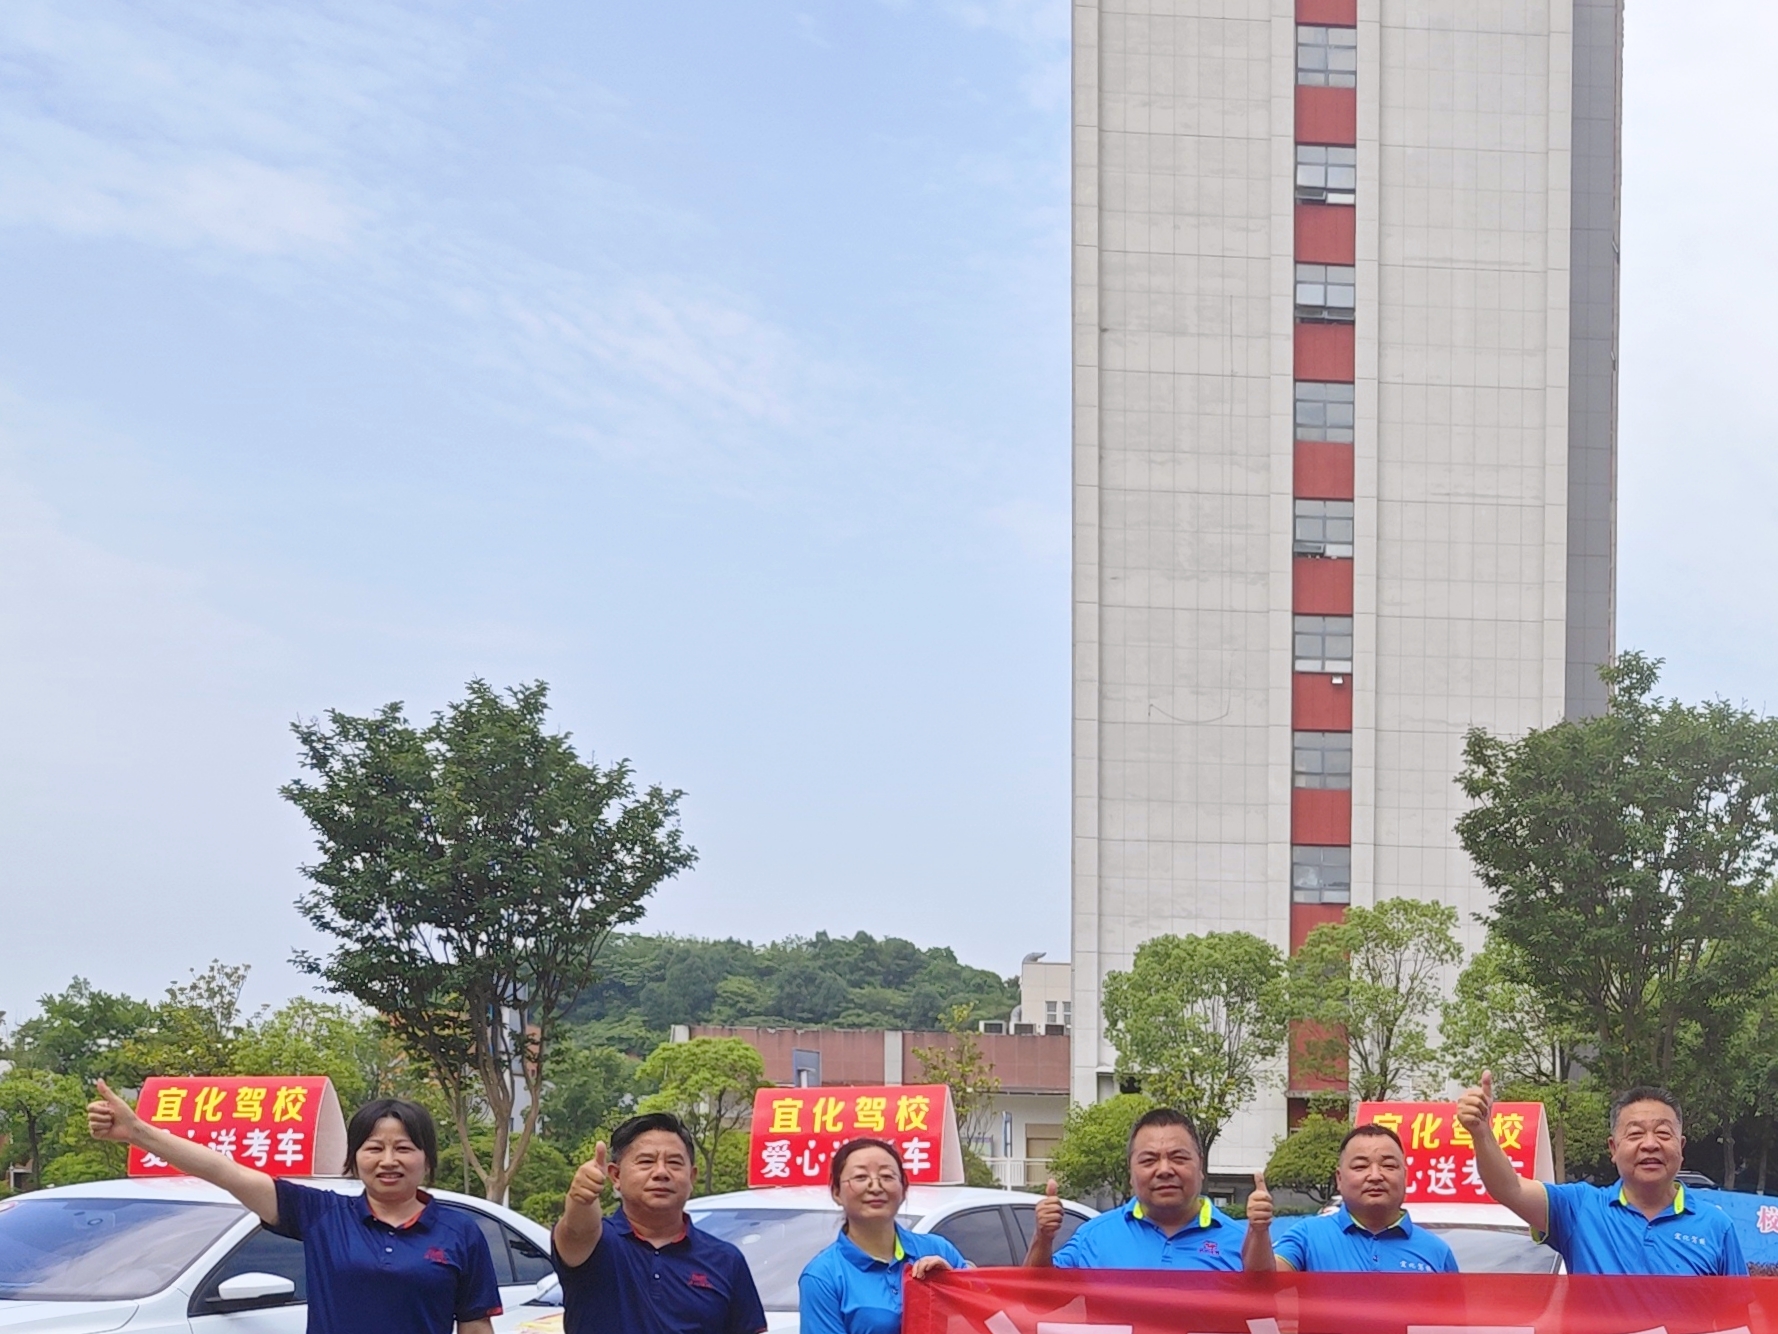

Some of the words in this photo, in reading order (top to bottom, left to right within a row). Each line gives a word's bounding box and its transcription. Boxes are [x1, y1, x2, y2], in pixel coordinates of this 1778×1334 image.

[151, 1086, 308, 1122] 宜化驾校
[768, 1095, 931, 1133] 宜化驾校
[140, 1127, 305, 1168] 送考车
[760, 1137, 931, 1178] 爱心车
